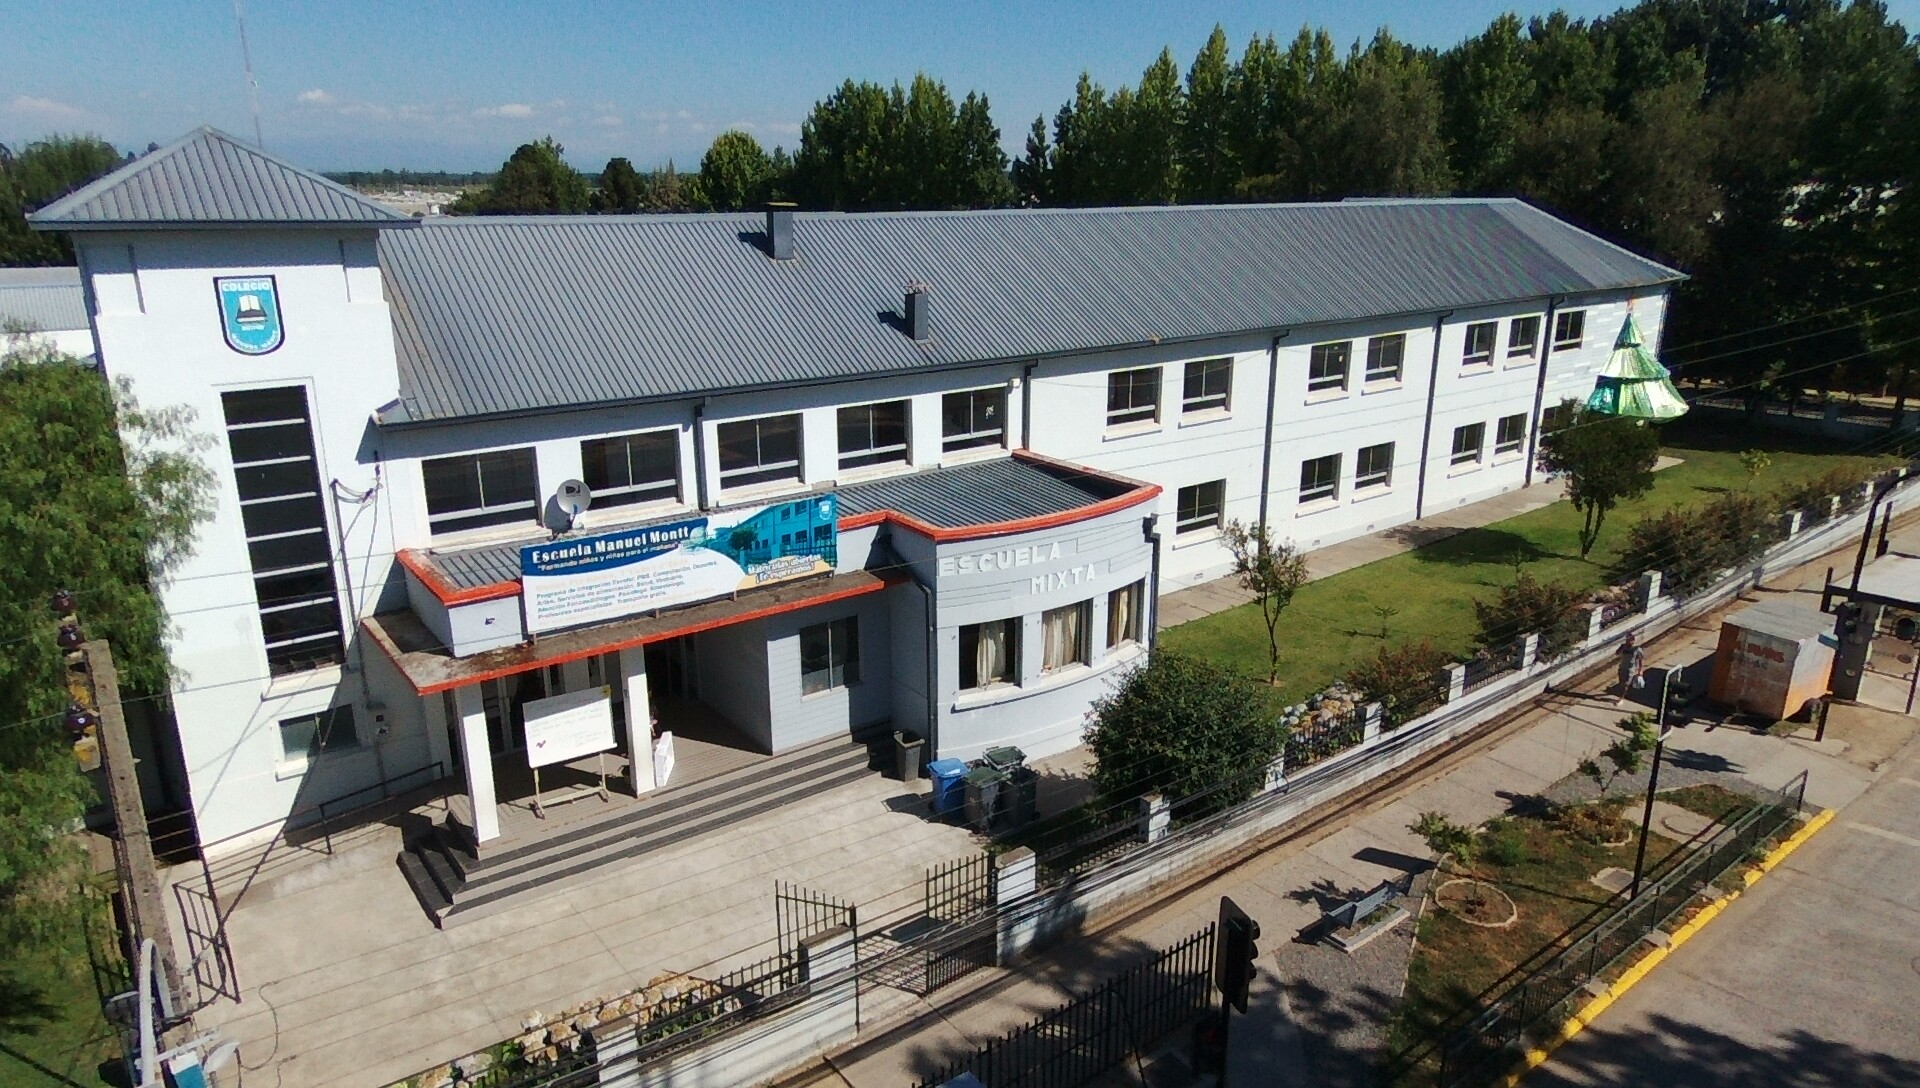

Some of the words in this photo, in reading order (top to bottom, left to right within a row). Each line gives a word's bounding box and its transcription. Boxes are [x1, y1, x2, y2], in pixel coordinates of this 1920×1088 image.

[222, 281, 270, 292] COLEGIO
[532, 543, 592, 564] Escuela
[595, 533, 647, 553] Manuel
[650, 526, 689, 543] Montt
[939, 542, 1061, 577] ESCUELA
[1031, 563, 1096, 595] MIXTA
